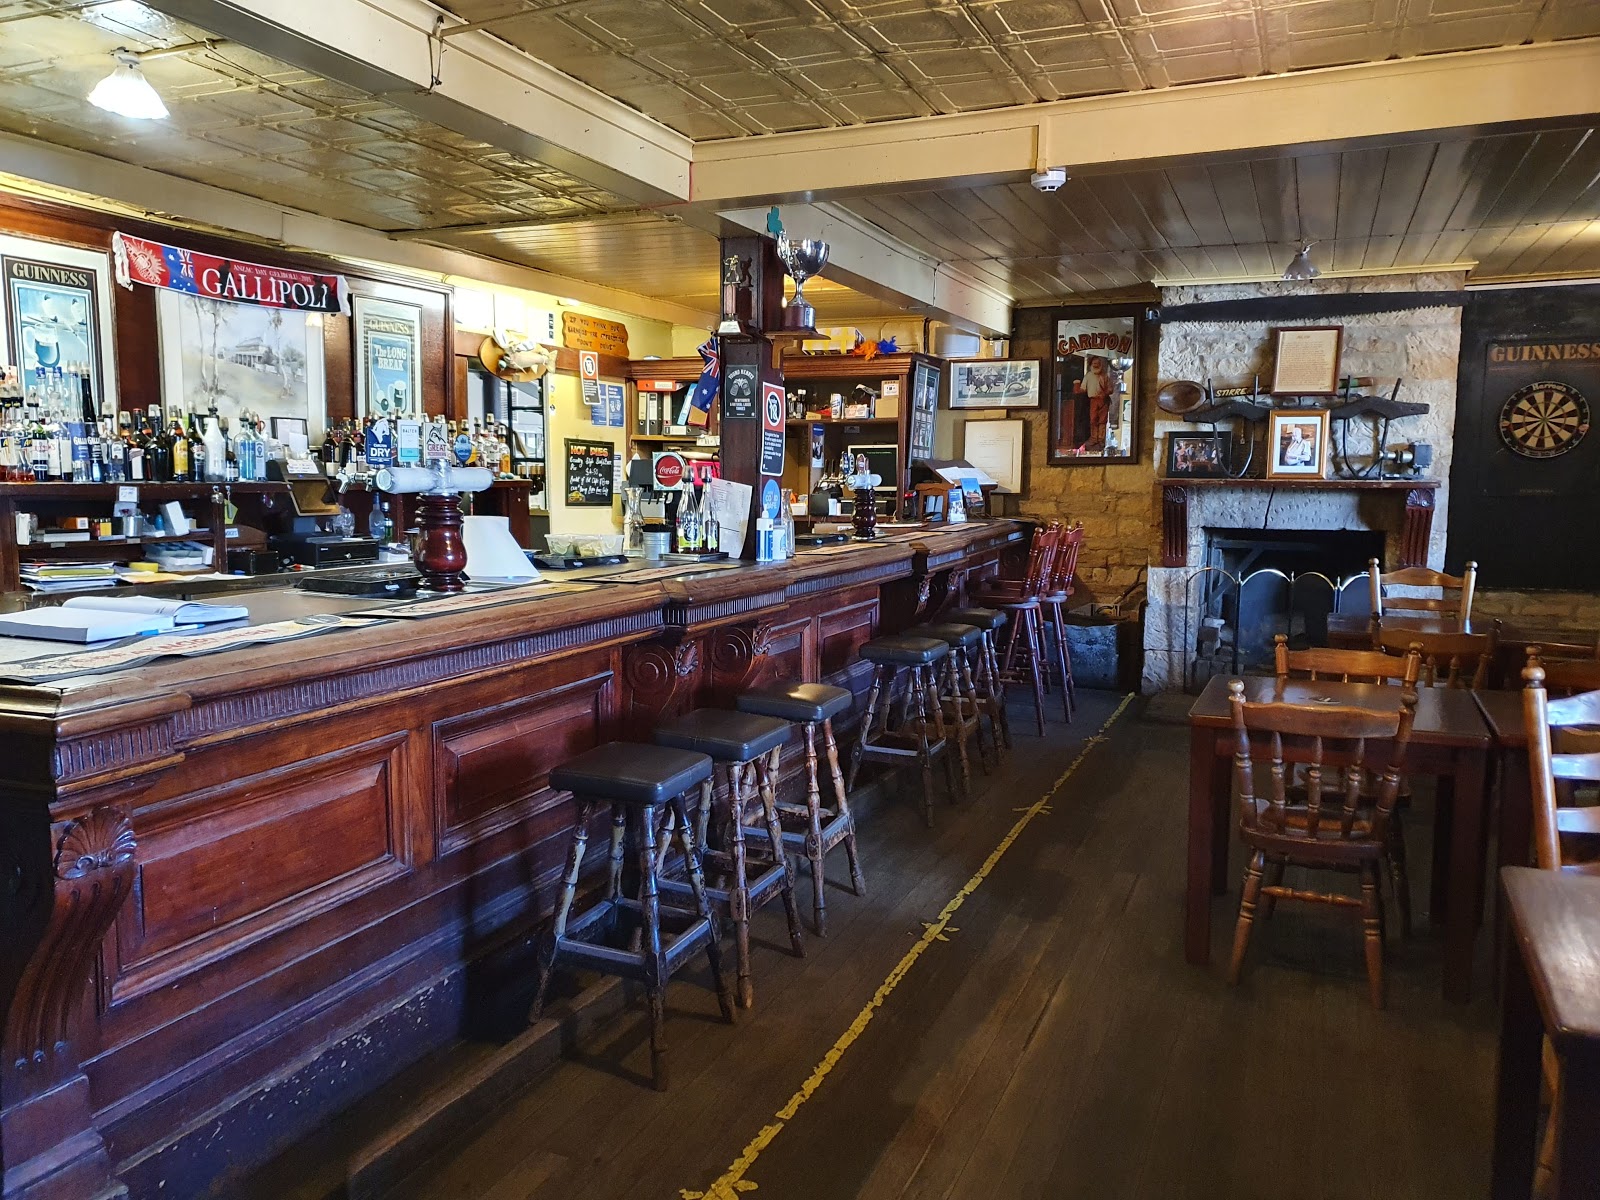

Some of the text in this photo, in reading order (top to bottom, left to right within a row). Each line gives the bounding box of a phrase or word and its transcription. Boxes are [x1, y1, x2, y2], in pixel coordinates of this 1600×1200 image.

[13, 262, 88, 287] GUINNESS
[233, 264, 253, 274] ANZAC
[255, 268, 268, 276] DAY
[202, 268, 328, 309] GALLIPOLI
[368, 319, 410, 334] GUINNESS
[1058, 332, 1132, 356] CARLTON
[373, 344, 407, 360] The LONG
[1491, 343, 1600, 362] GUINNESS
[377, 357, 405, 372] BREAK
[370, 448, 390, 457] DRY
[427, 443, 447, 452] GREAT
[570, 445, 609, 457] HOT PIES
